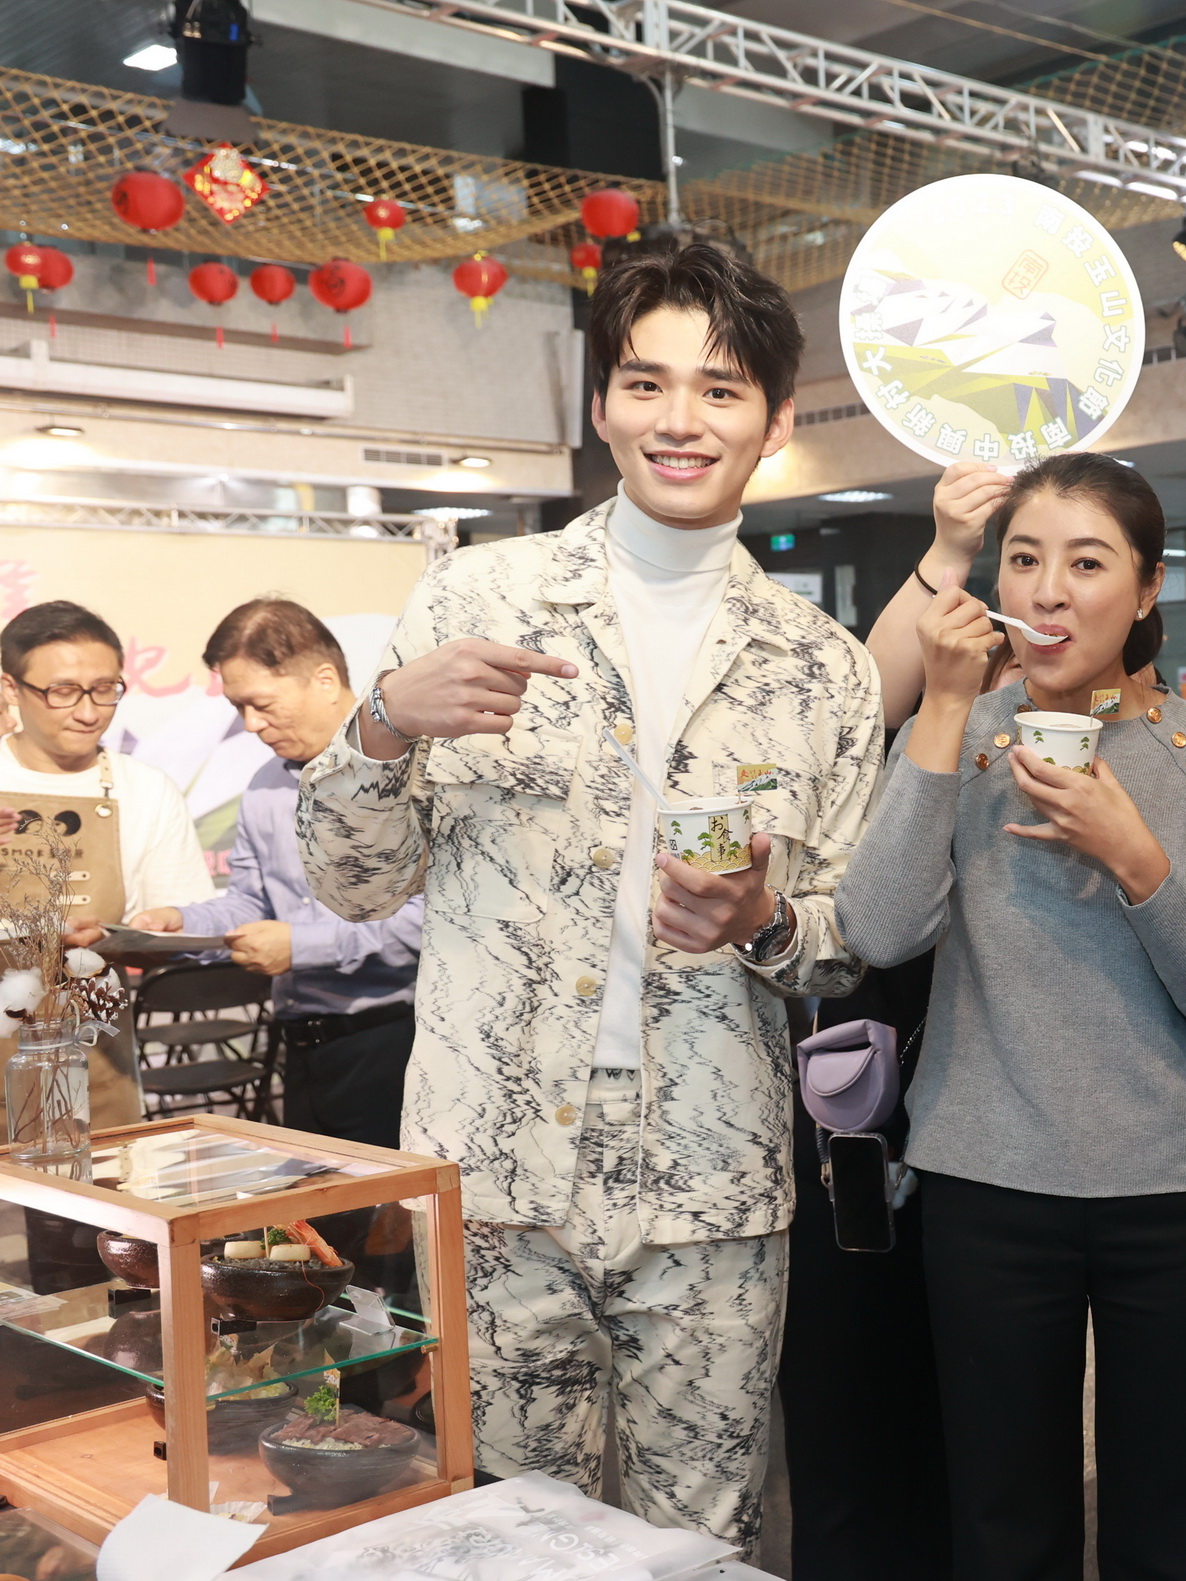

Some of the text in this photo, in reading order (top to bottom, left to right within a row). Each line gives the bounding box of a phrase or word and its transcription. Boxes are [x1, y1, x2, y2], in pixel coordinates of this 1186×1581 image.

[1005, 252, 1044, 298] 南投
[711, 815, 733, 860] お食事
